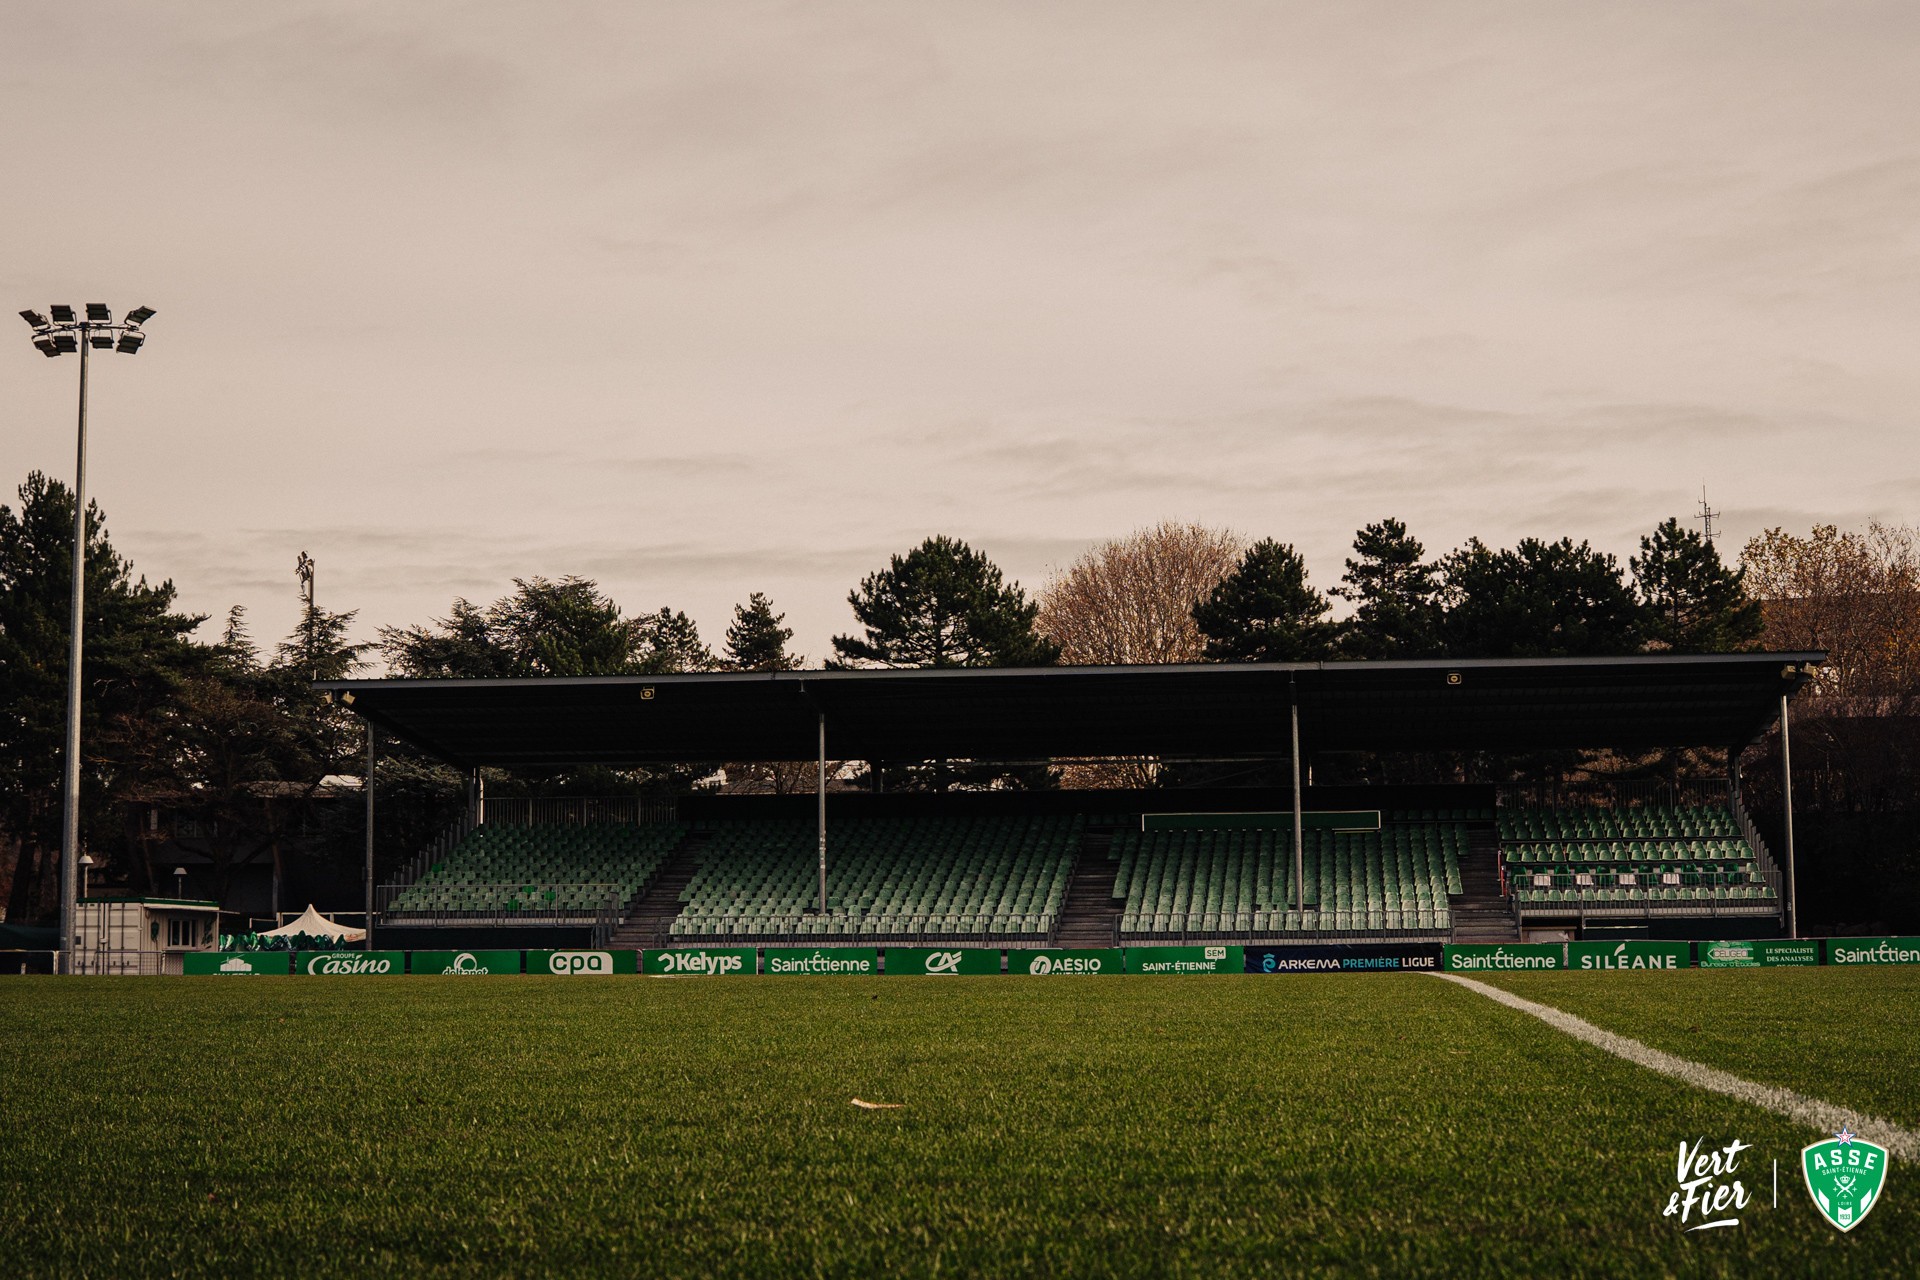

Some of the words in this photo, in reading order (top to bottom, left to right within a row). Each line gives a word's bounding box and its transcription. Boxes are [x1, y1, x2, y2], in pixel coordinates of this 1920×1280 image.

[553, 955, 602, 975] cpa
[676, 952, 742, 975] Kelyps
[1278, 959, 1341, 970] ARKEMA
[1402, 957, 1435, 968] LIGUE
